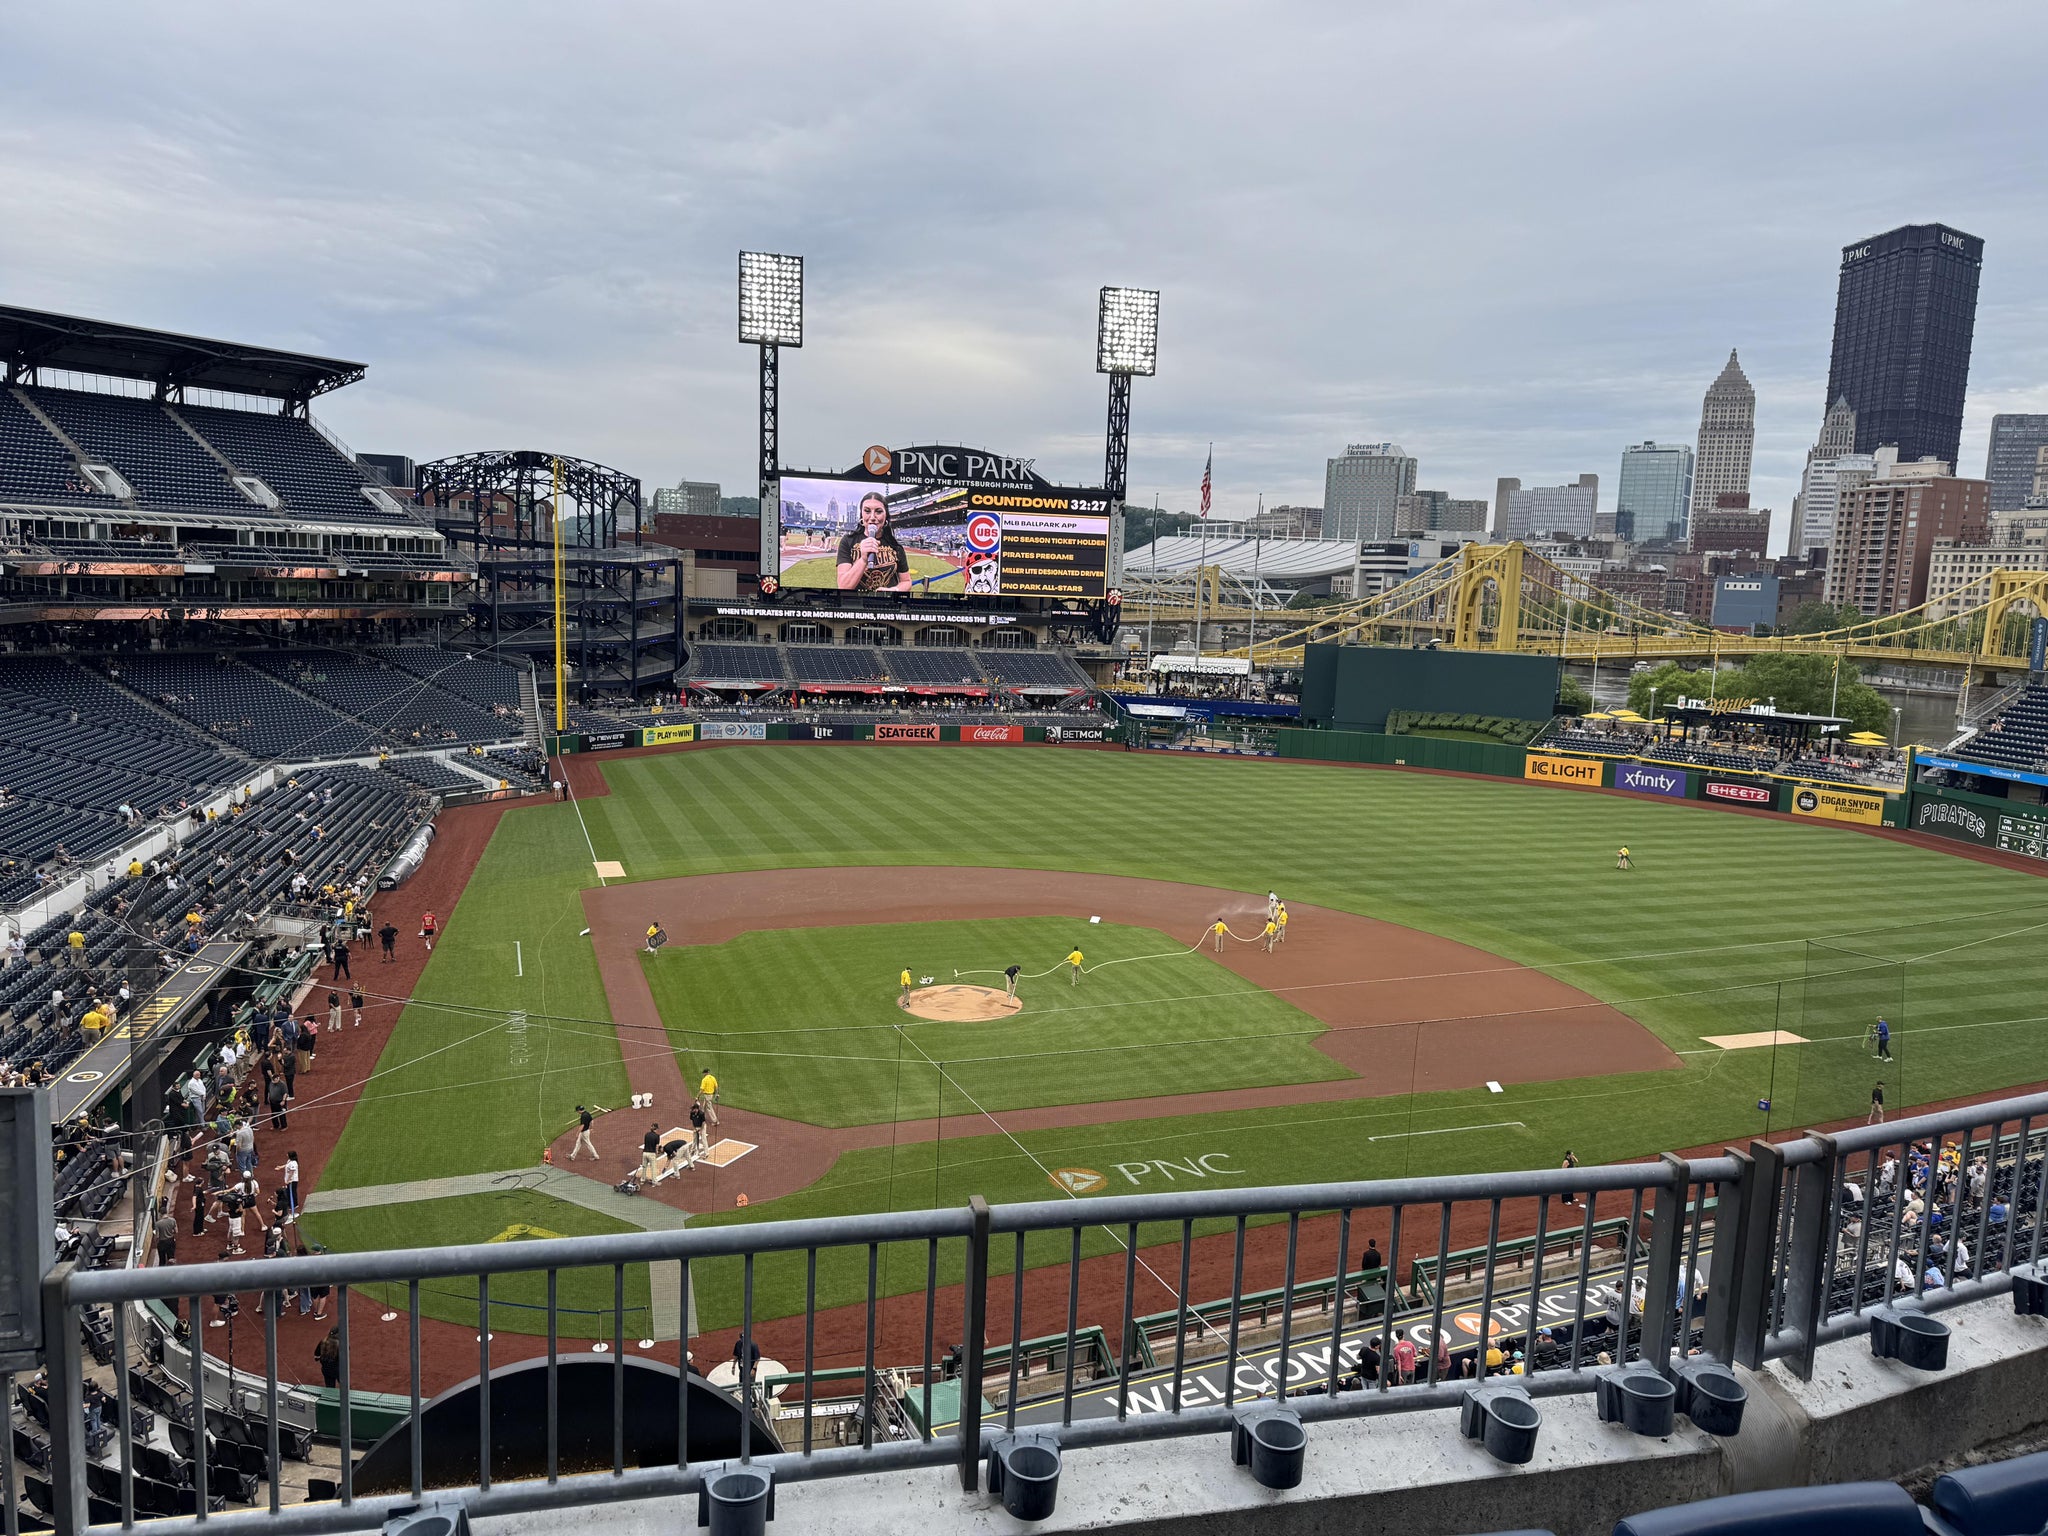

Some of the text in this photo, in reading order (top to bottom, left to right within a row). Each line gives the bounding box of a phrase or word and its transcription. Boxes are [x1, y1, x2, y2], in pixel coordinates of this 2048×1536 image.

[1942, 232, 1965, 250] UPMC
[1841, 245, 1871, 263] UPMC
[897, 450, 1036, 481] PNC PARK
[900, 476, 922, 484] HOME
[937, 478, 952, 486] THE
[954, 480, 1000, 488] PITTSBURGH
[1002, 482, 1033, 490] PIRATES
[971, 494, 1107, 511] COUNTDOWN 32:27
[1021, 520, 1060, 528] BALLPARK
[1020, 536, 1050, 544] SEASON
[1051, 537, 1077, 545] TICKET
[1002, 551, 1074, 560] PIRATES PREGAME
[1039, 568, 1080, 576] DESIGNATED
[1042, 584, 1083, 592] ALL-STARS
[855, 612, 876, 620] RUNS,
[1687, 697, 1776, 717] IT'S Miller TIME
[657, 731, 672, 739] PLAY
[678, 729, 692, 737] WIN!
[749, 724, 764, 735] 125
[814, 727, 833, 739] Lite
[878, 727, 936, 739] SEATGEEK
[1062, 730, 1103, 739] BETMGM
[1532, 761, 1596, 780] IC LIGHT
[1625, 770, 1676, 792] xfinity
[1711, 785, 1766, 800] SHEETZ
[1821, 796, 1880, 812] EDGAR SNYDER
[1839, 807, 1864, 815] ASSOCIATES
[1882, 820, 1895, 828] 375
[1920, 803, 1986, 839] PIRATES
[114, 996, 182, 1039] PIRATES
[1109, 1153, 1246, 1185] PNC
[1104, 1338, 1366, 1415] WELCOME
[1491, 1295, 1575, 1327] PNC
